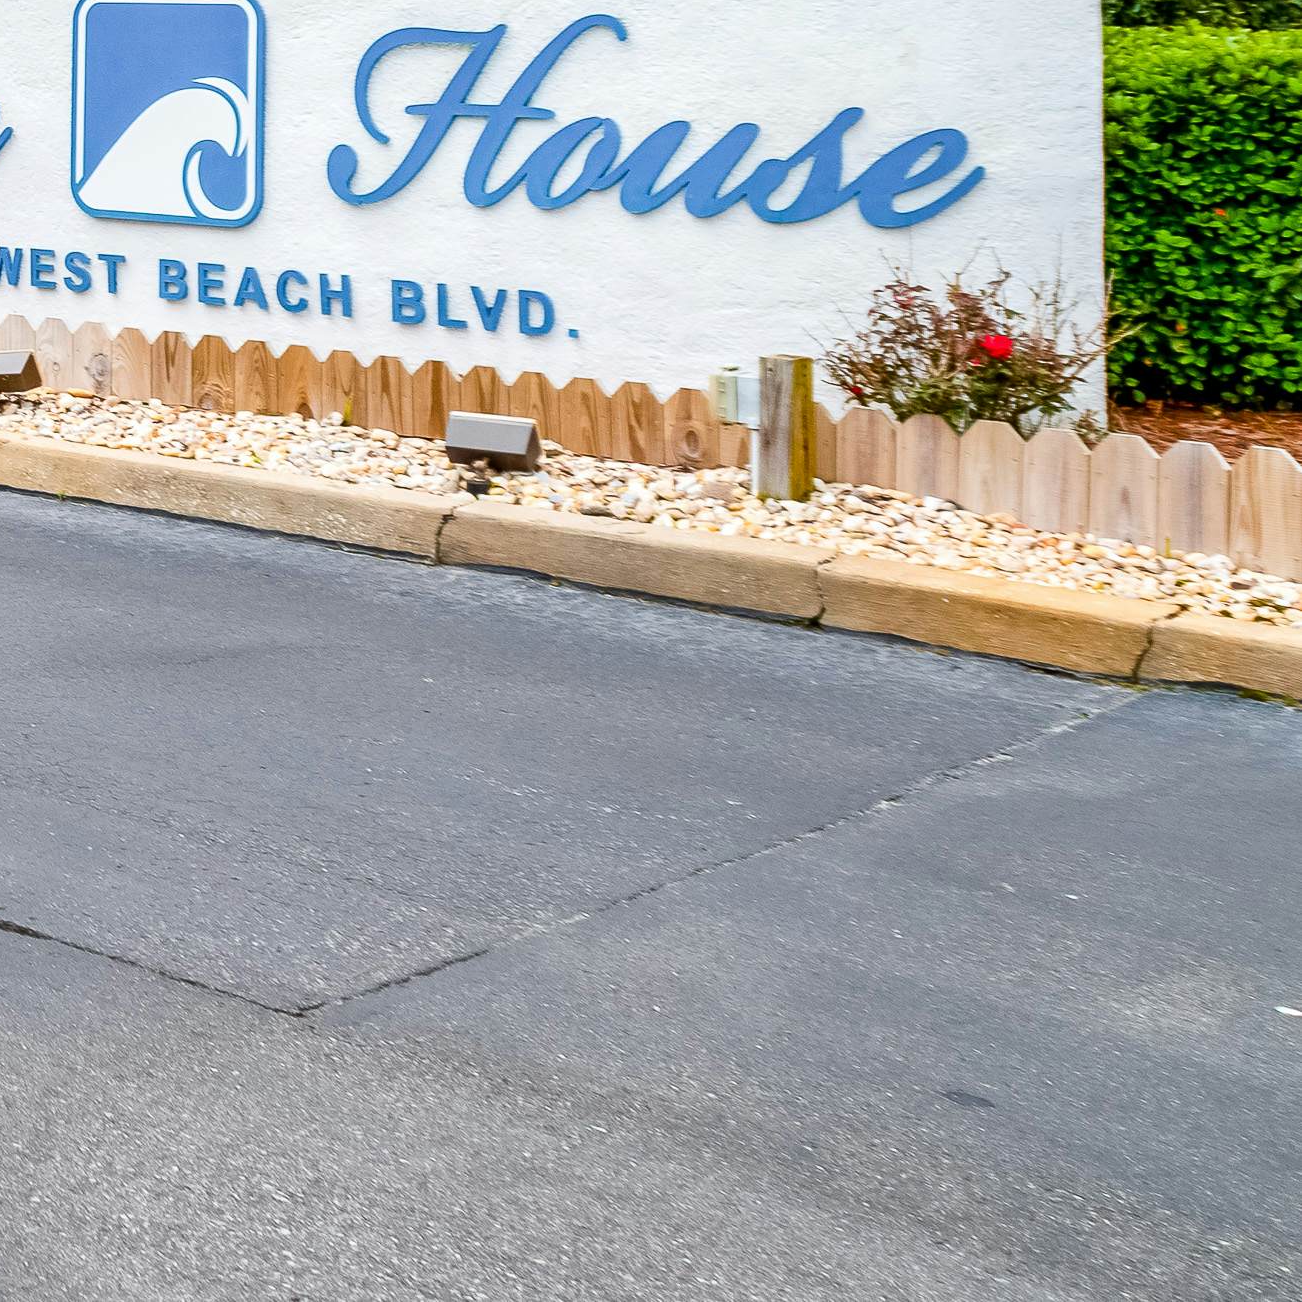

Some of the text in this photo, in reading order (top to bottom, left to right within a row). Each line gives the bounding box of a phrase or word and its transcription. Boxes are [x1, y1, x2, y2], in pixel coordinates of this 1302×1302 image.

[327, 13, 986, 228] House
[158, 257, 354, 318] BEACH
[391, 279, 581, 339] BLVD.
